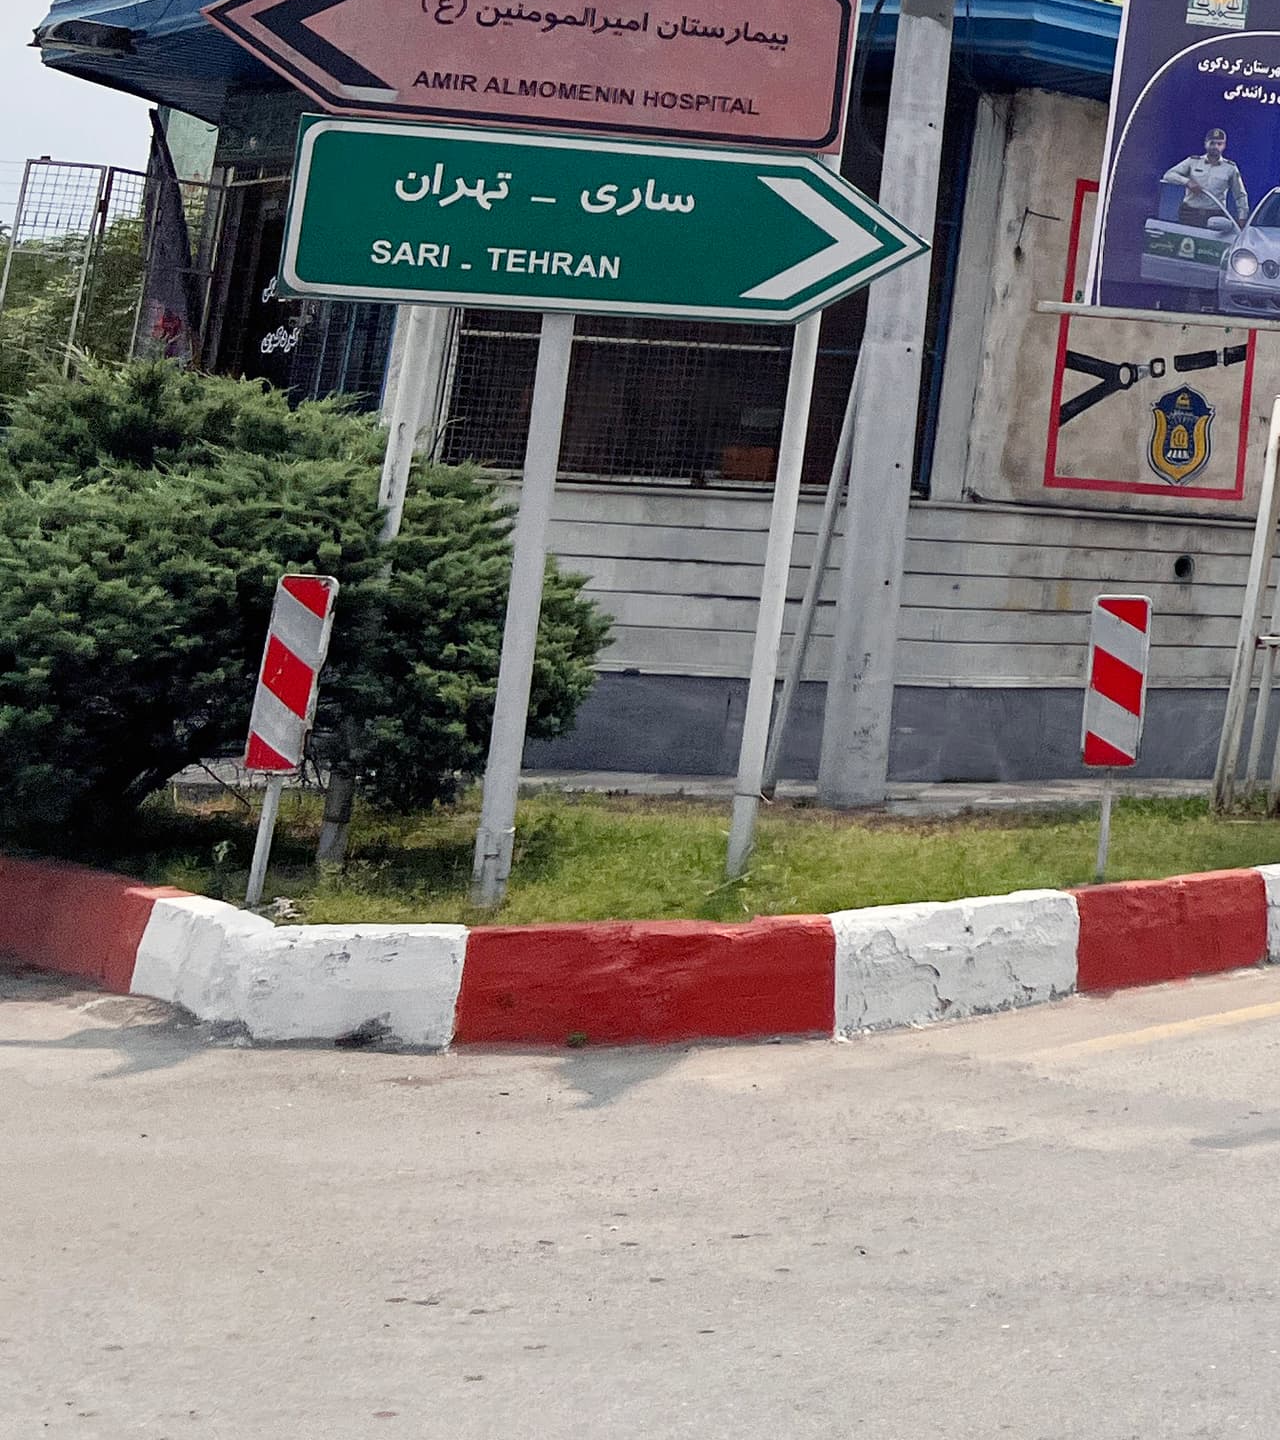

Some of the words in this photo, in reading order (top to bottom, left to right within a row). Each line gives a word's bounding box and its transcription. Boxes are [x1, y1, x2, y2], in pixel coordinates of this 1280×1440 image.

[476, 2, 649, 35] امیرالمومنین
[656, 16, 789, 52] بیمارستان
[412, 70, 478, 92] AMIR
[483, 78, 635, 106] ALMOMENIN
[642, 90, 760, 115] HOSPITAL
[1224, 85, 1267, 103] رانندگی
[1269, 93, 1275, 104] و
[395, 163, 512, 210] تهران
[580, 179, 695, 216] ساری
[371, 240, 450, 268] SARI
[487, 247, 620, 279] TEHRAN
